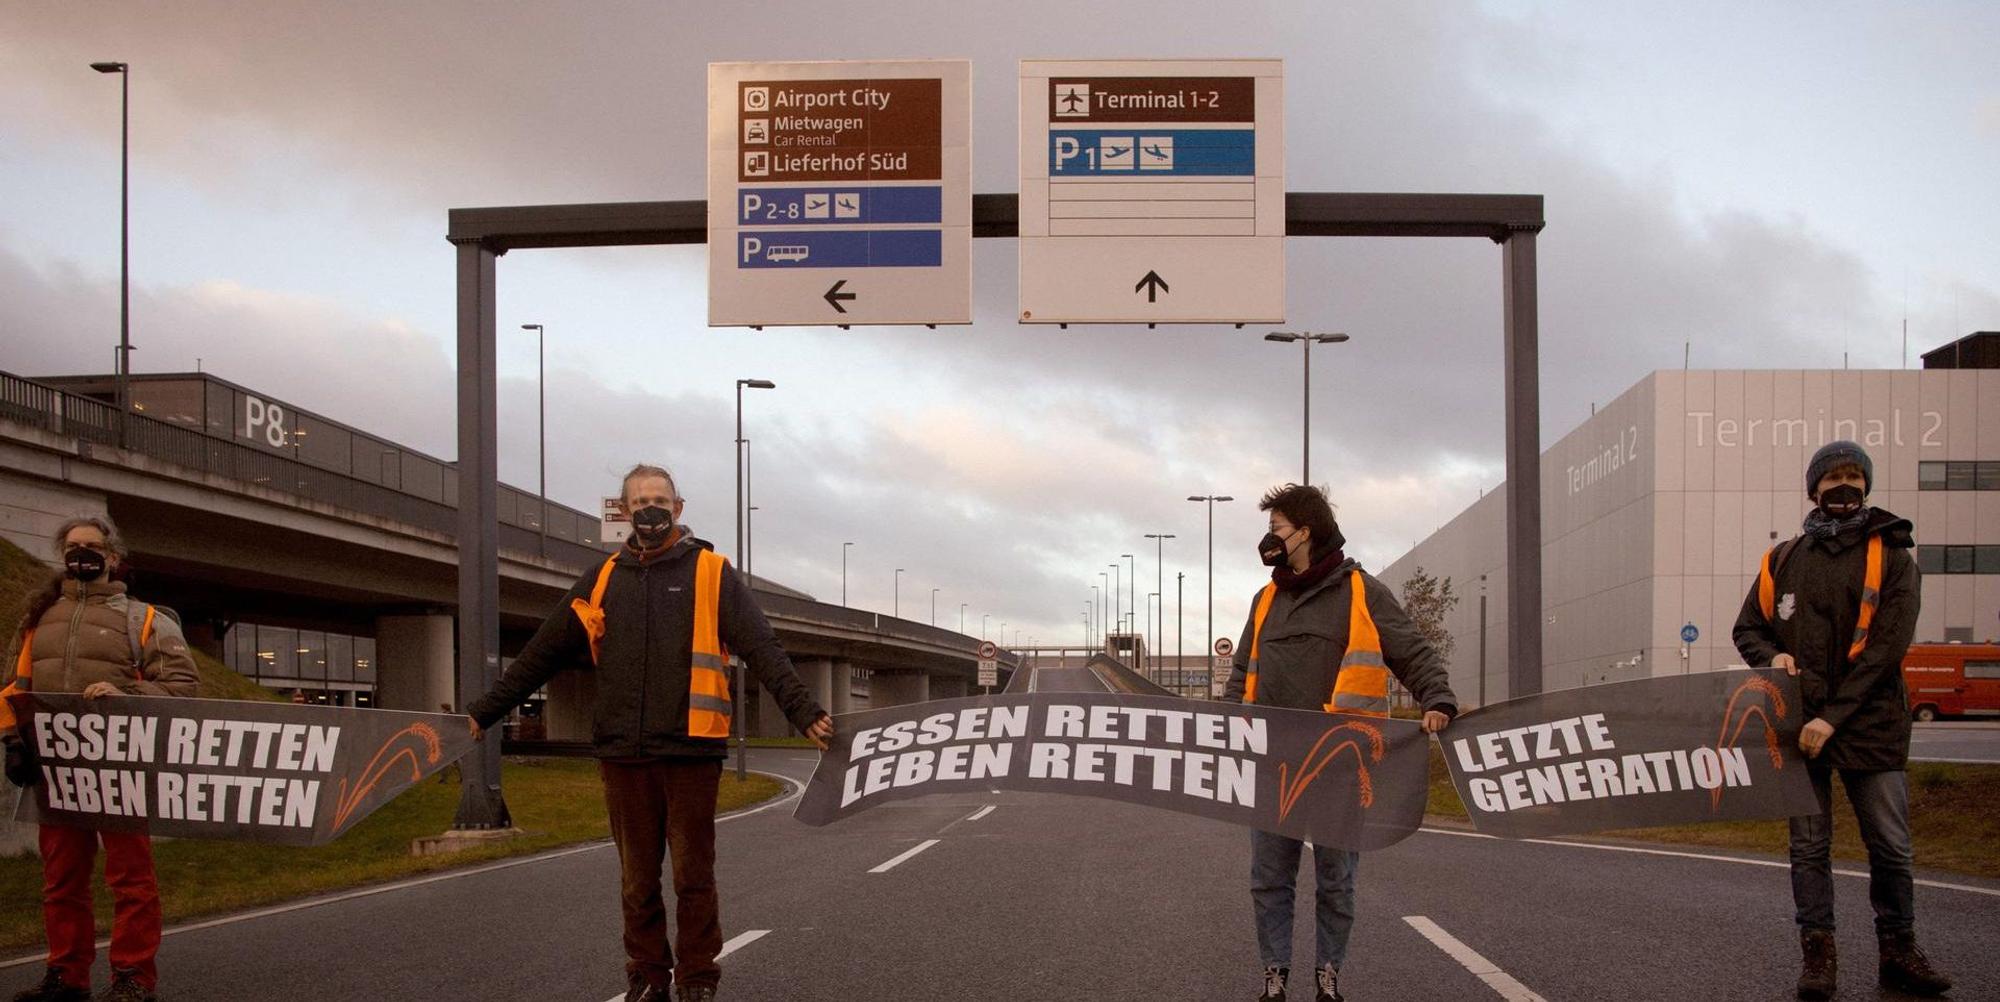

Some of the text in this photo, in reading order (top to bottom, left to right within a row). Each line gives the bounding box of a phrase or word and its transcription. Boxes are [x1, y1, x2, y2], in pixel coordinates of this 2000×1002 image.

[774, 88, 891, 111] Airport City
[1095, 91, 1220, 109] Terminal 1-2
[774, 116, 863, 132] Mietwagen
[774, 134, 836, 146] Car Rental
[774, 152, 907, 172] Lieferhof Süd
[1055, 137, 1096, 170] P 1
[744, 194, 800, 220] P 2-8
[744, 237, 761, 263] P
[245, 394, 285, 448] P8
[1687, 408, 1943, 448] Terminal 2
[1566, 426, 1638, 497] Terminal 2
[34, 712, 341, 773] ESSEN RETTEN
[850, 704, 1268, 763] ESSEN RETTEN
[1453, 712, 1616, 773] LETZTE
[840, 742, 1257, 809] LEBEN RETTEN
[1468, 746, 1753, 814] GENERATION
[41, 764, 320, 829] LEBEN RETTEN
